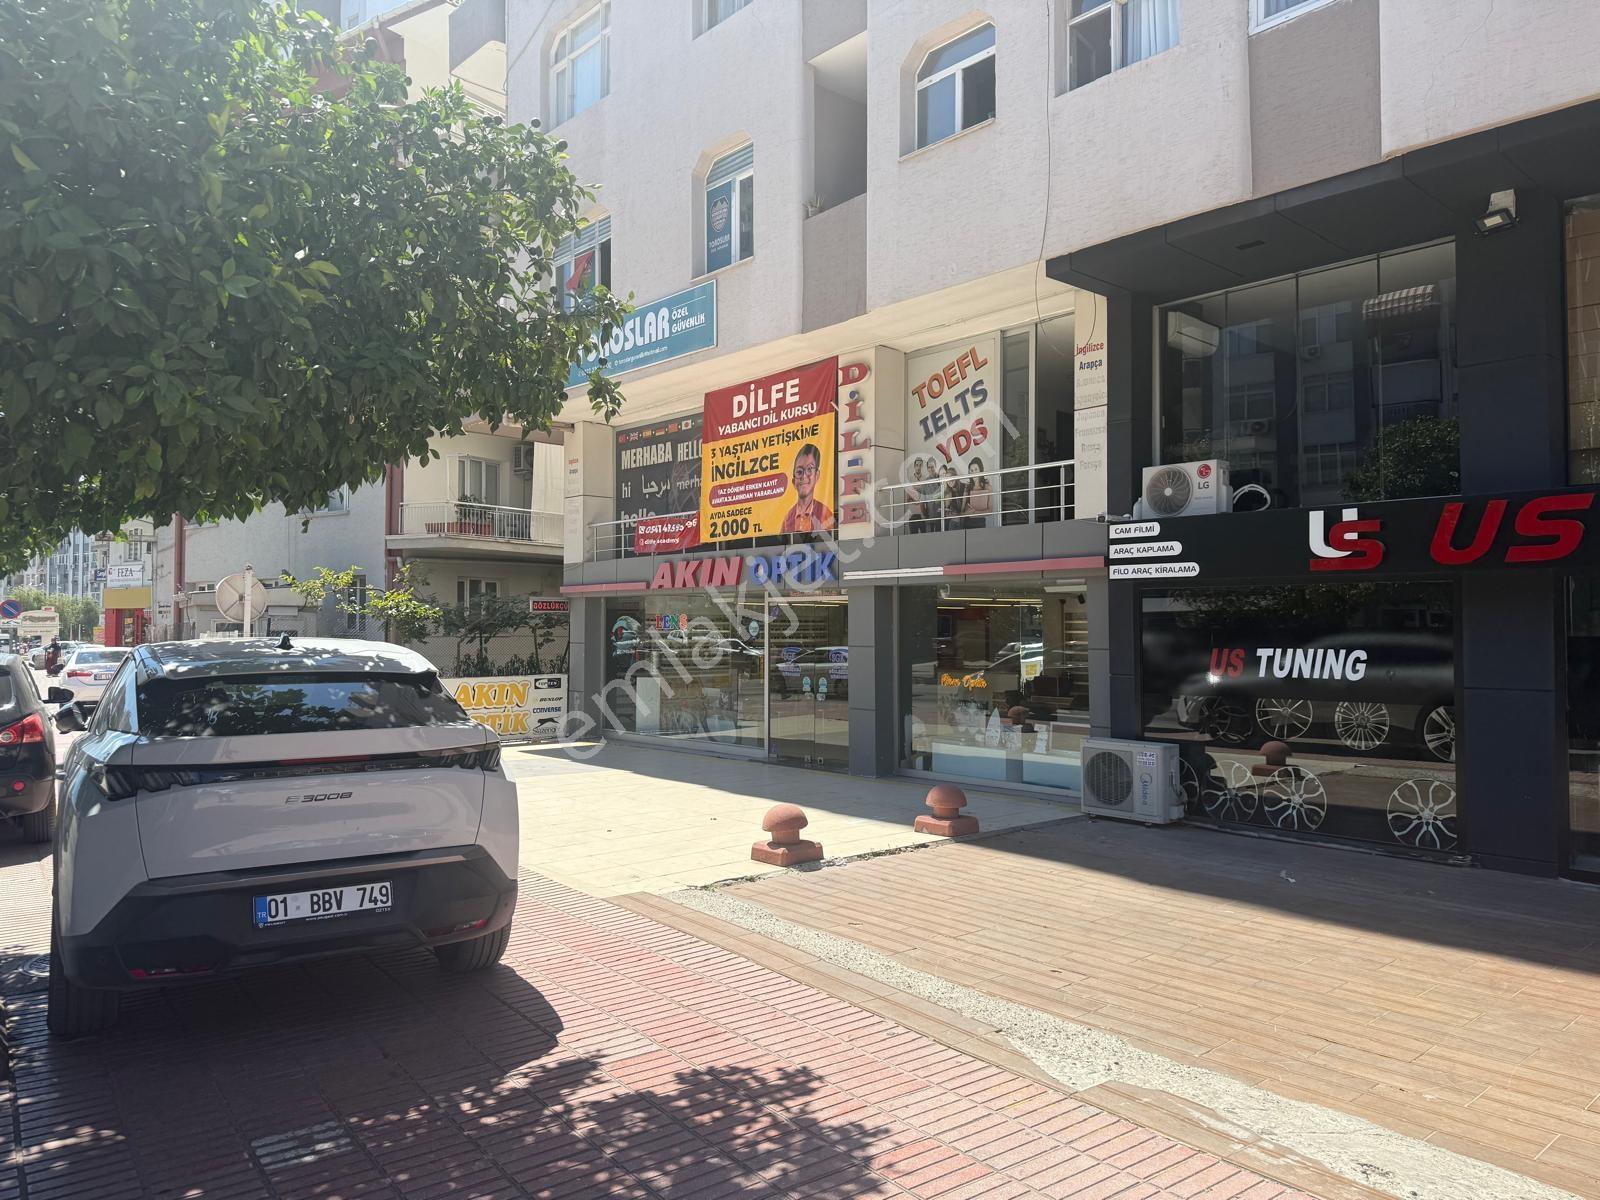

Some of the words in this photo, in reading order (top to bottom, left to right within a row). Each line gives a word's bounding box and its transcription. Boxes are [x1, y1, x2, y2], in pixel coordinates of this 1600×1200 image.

[672, 306, 689, 319] ÖZEL
[672, 313, 705, 333] GÜVENLİK
[1076, 342, 1105, 356] İngilizce
[1079, 359, 1103, 371] Arapça
[912, 346, 988, 409] TOEFL
[732, 378, 800, 419] DİLFE
[718, 416, 760, 436] YABANCI
[763, 410, 778, 426] DİL
[780, 402, 817, 421] KURSU
[919, 379, 988, 441] IELTS
[711, 448, 716, 460] 3
[719, 439, 759, 458] YAŞTAN
[762, 423, 819, 446] YETİŞKİNE
[936, 417, 988, 464] YDS
[621, 441, 673, 470] MERHABA
[711, 453, 779, 482] İNGİLZCE
[622, 482, 631, 498] hi
[746, 482, 762, 491] ERKEN
[763, 479, 778, 487] KAYIT
[1197, 481, 1210, 490] LG
[710, 511, 726, 520] AYDA
[726, 507, 752, 516] SADECE
[709, 517, 749, 538] 2.000
[753, 523, 762, 533] TL
[1114, 527, 1132, 535] CAM
[1134, 525, 1155, 533] FİLMİ
[1430, 493, 1595, 565] US
[1113, 547, 1134, 555] ARAÇ
[1136, 544, 1175, 553] KAPLAMA
[651, 555, 743, 590] AKIN
[1131, 566, 1152, 575] ARAÇ
[1155, 563, 1197, 574] KİRALAMA
[655, 613, 688, 631] LENS
[1209, 648, 1246, 678] US
[1256, 648, 1368, 682] TUNING
[454, 681, 531, 710] AKIN
[532, 706, 562, 714] CONVERSE
[257, 911, 267, 919] TR
[268, 896, 288, 919] 01
[310, 890, 344, 914] BBV
[357, 885, 390, 908] 749
